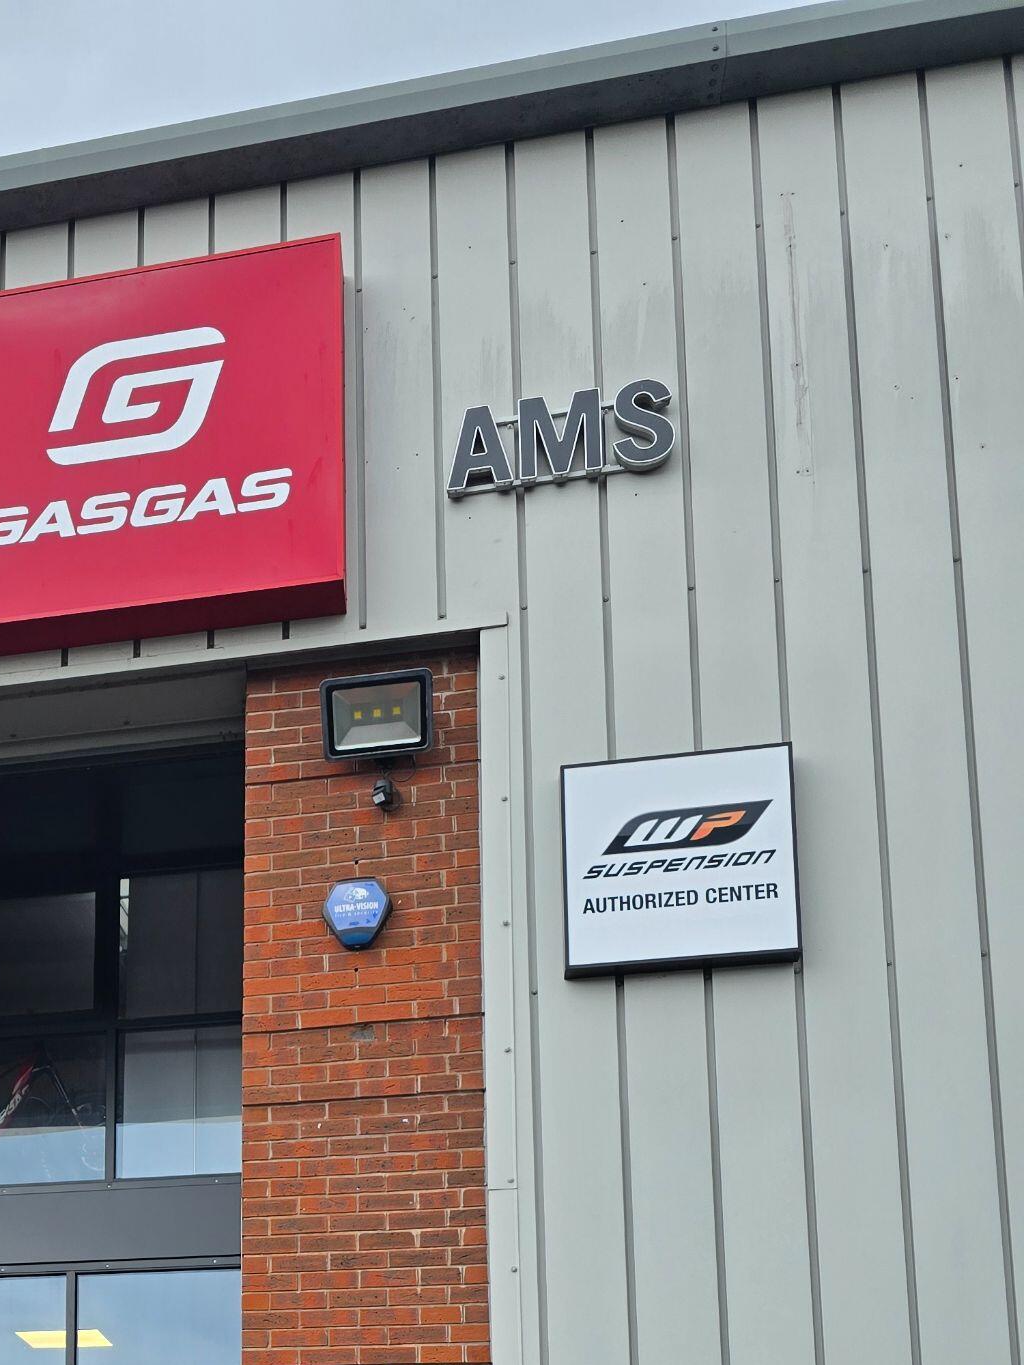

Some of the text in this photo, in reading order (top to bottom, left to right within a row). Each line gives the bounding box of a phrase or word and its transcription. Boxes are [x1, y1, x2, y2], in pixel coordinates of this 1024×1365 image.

[447, 378, 676, 492] AMS
[582, 848, 776, 880] SUSPENSION
[582, 882, 779, 915] AUTHORIZED CENTER
